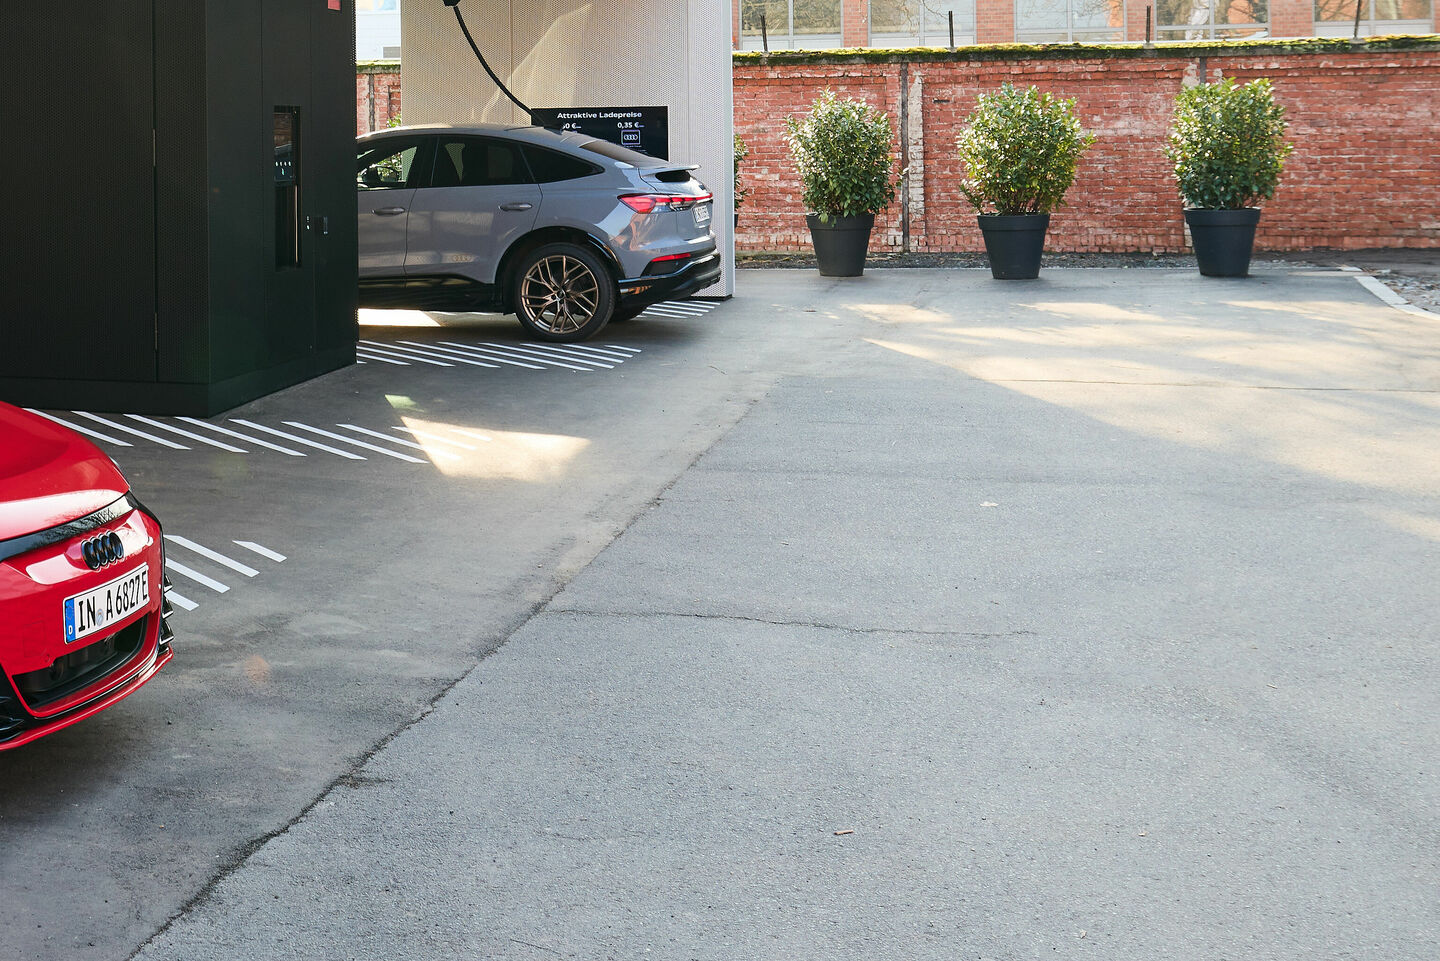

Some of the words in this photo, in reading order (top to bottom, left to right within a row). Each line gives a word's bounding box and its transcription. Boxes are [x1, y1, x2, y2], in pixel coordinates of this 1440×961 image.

[599, 111, 642, 119] Ladepreise
[78, 596, 96, 632] IN
[68, 625, 73, 635] D
